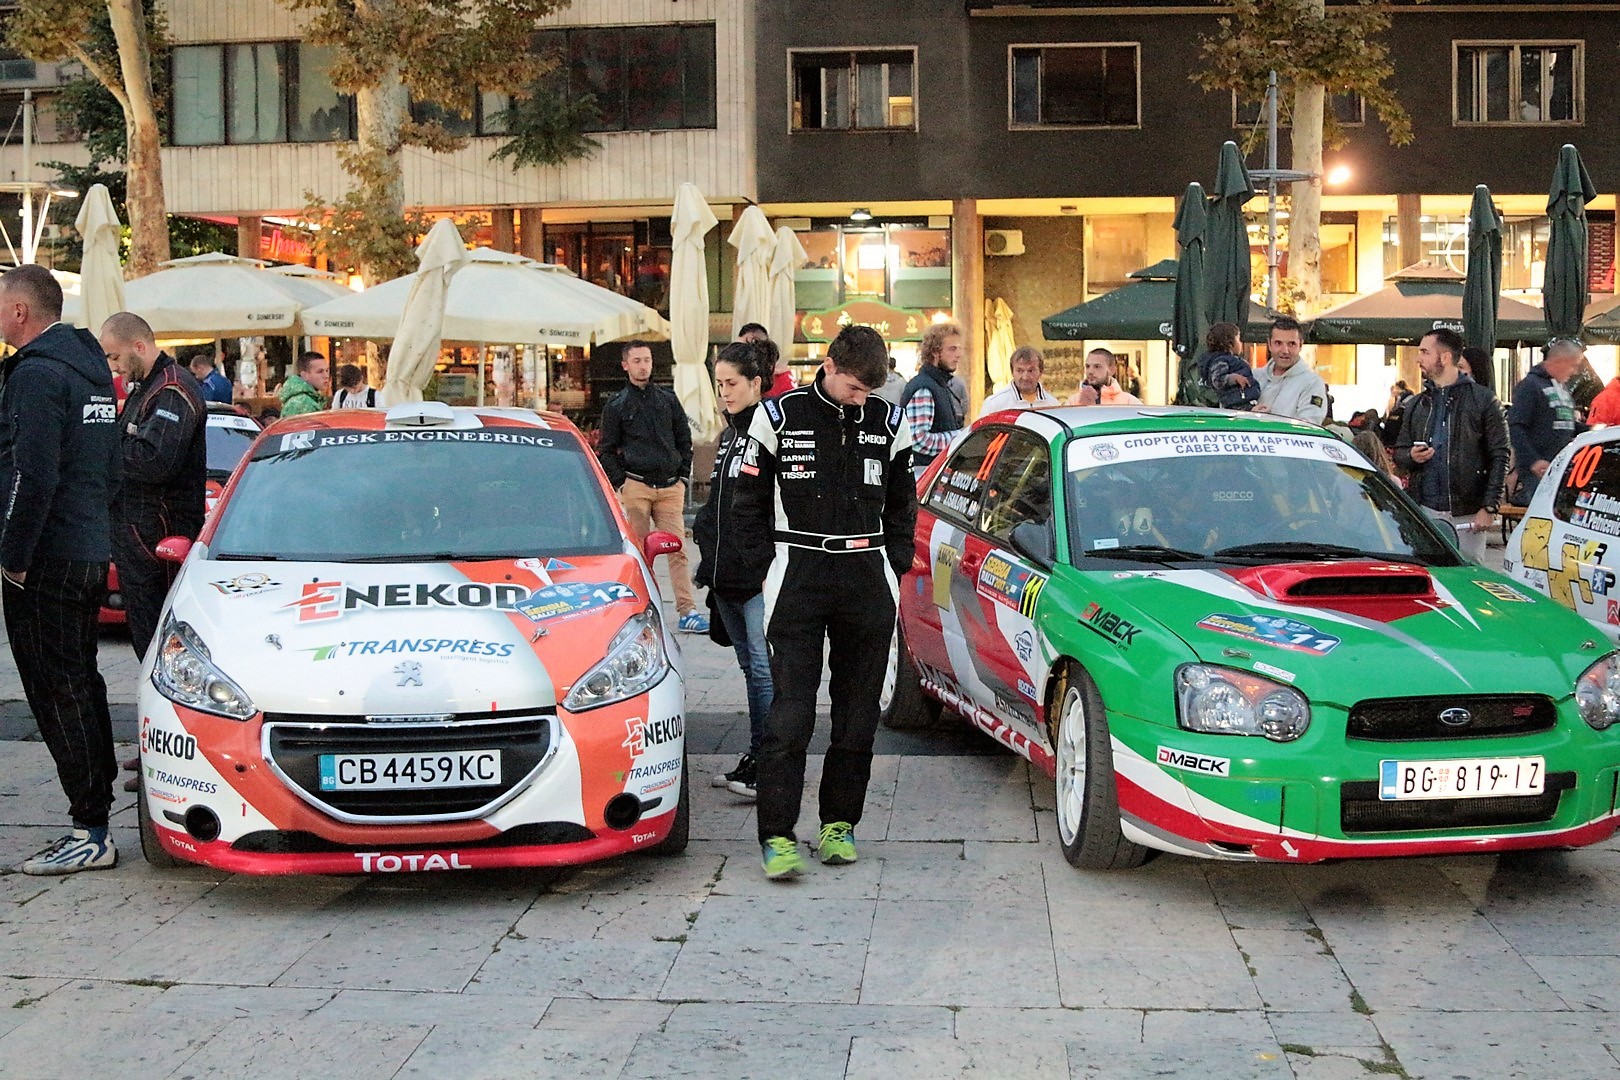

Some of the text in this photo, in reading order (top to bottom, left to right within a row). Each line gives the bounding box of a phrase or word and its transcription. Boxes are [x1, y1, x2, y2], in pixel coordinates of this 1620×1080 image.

[320, 433, 377, 447] RISK
[383, 431, 554, 447] ENGINEERING
[1124, 434, 1315, 449] СПОРТСКИ АУТО И КАРТИНГ
[1176, 443, 1276, 454] САВЕЗ СРБИЈЕ
[781, 454, 815, 462] GARMIN
[1566, 445, 1603, 488] 10
[781, 471, 817, 479] TISSOT
[1212, 491, 1253, 500] sparco
[593, 584, 634, 602] 12
[1023, 575, 1045, 618] 11
[348, 638, 515, 657] TRANSPRESS
[1289, 634, 1339, 650] 11
[630, 757, 681, 780] TRANSPRESS
[156, 770, 217, 794] TRANSPRESS
[323, 776, 335, 785] BG
[169, 836, 196, 852] TOTAL
[632, 831, 656, 844] TOTAL
[354, 852, 472, 872] TOTAL
